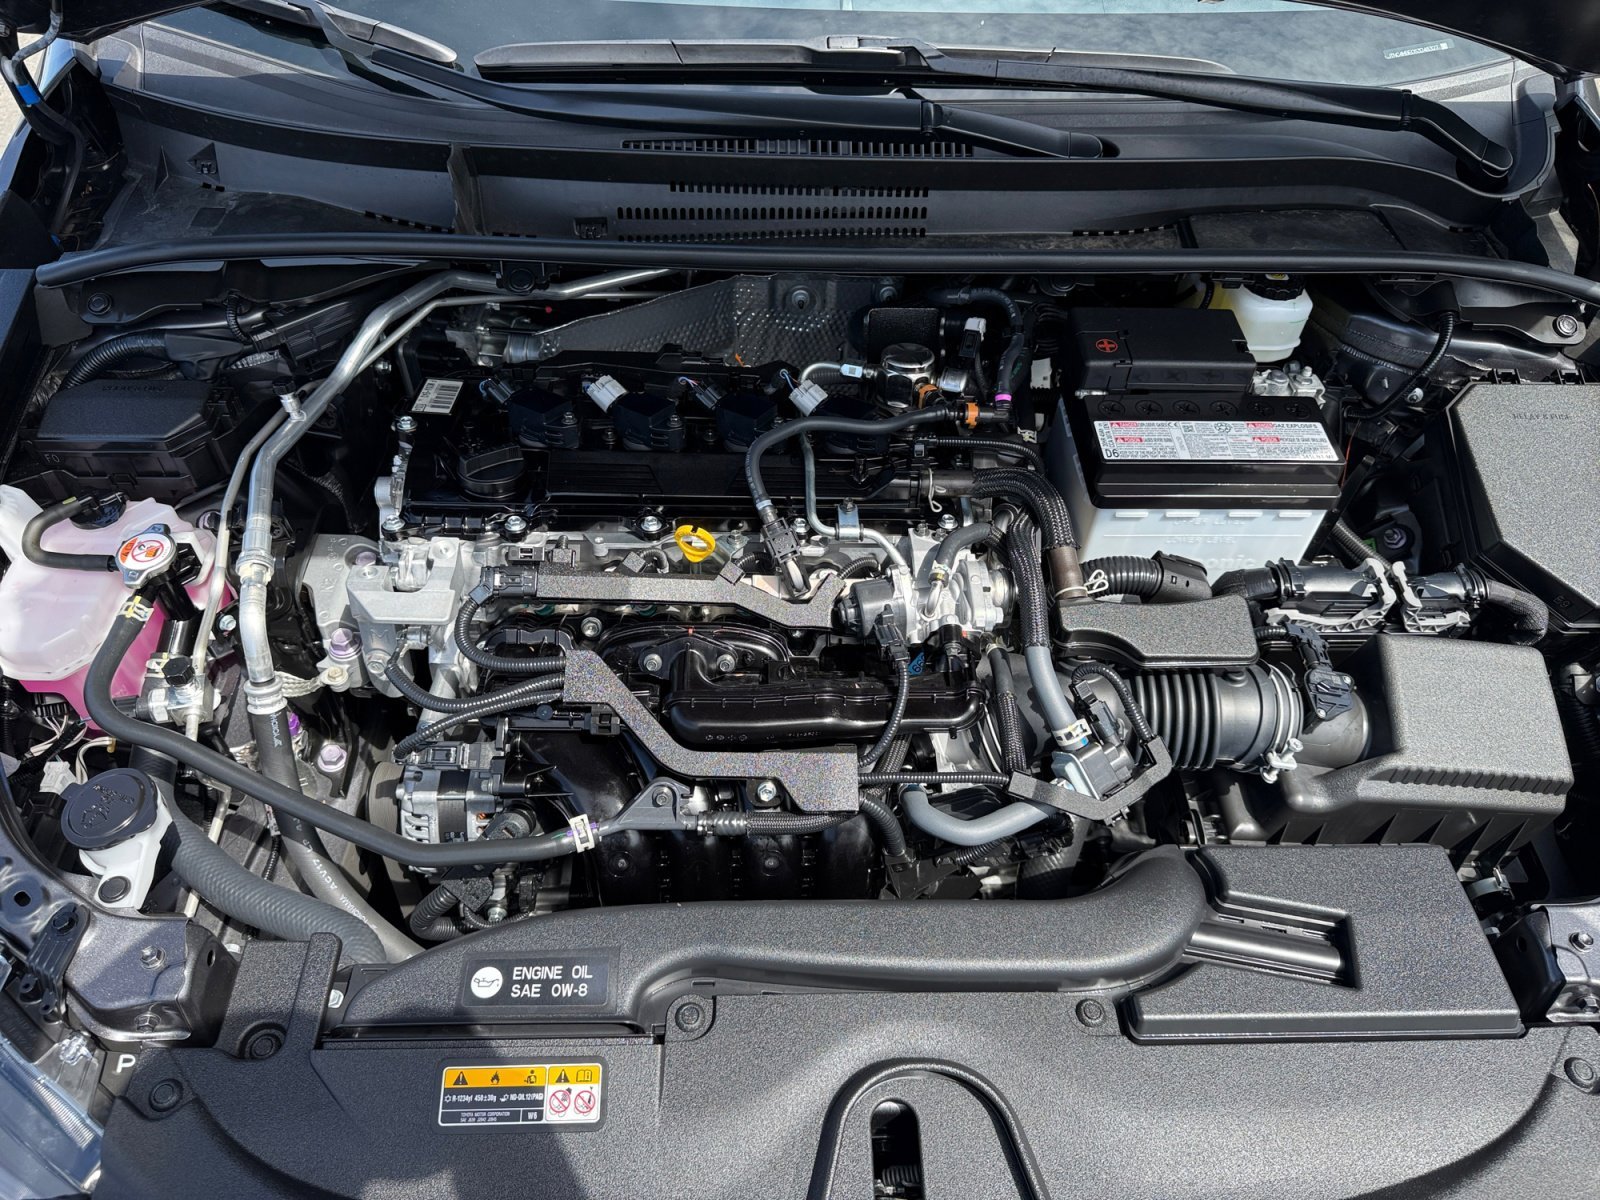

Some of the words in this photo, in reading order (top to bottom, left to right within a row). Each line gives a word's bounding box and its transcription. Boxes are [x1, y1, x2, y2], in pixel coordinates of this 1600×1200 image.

[1105, 449, 1120, 458] D6
[312, 858, 338, 890] ACV17
[512, 965, 563, 980] ENGINE
[571, 965, 593, 979] OIL
[510, 983, 541, 998] SAE
[551, 983, 588, 998] 0W-8
[116, 1053, 136, 1073] P
